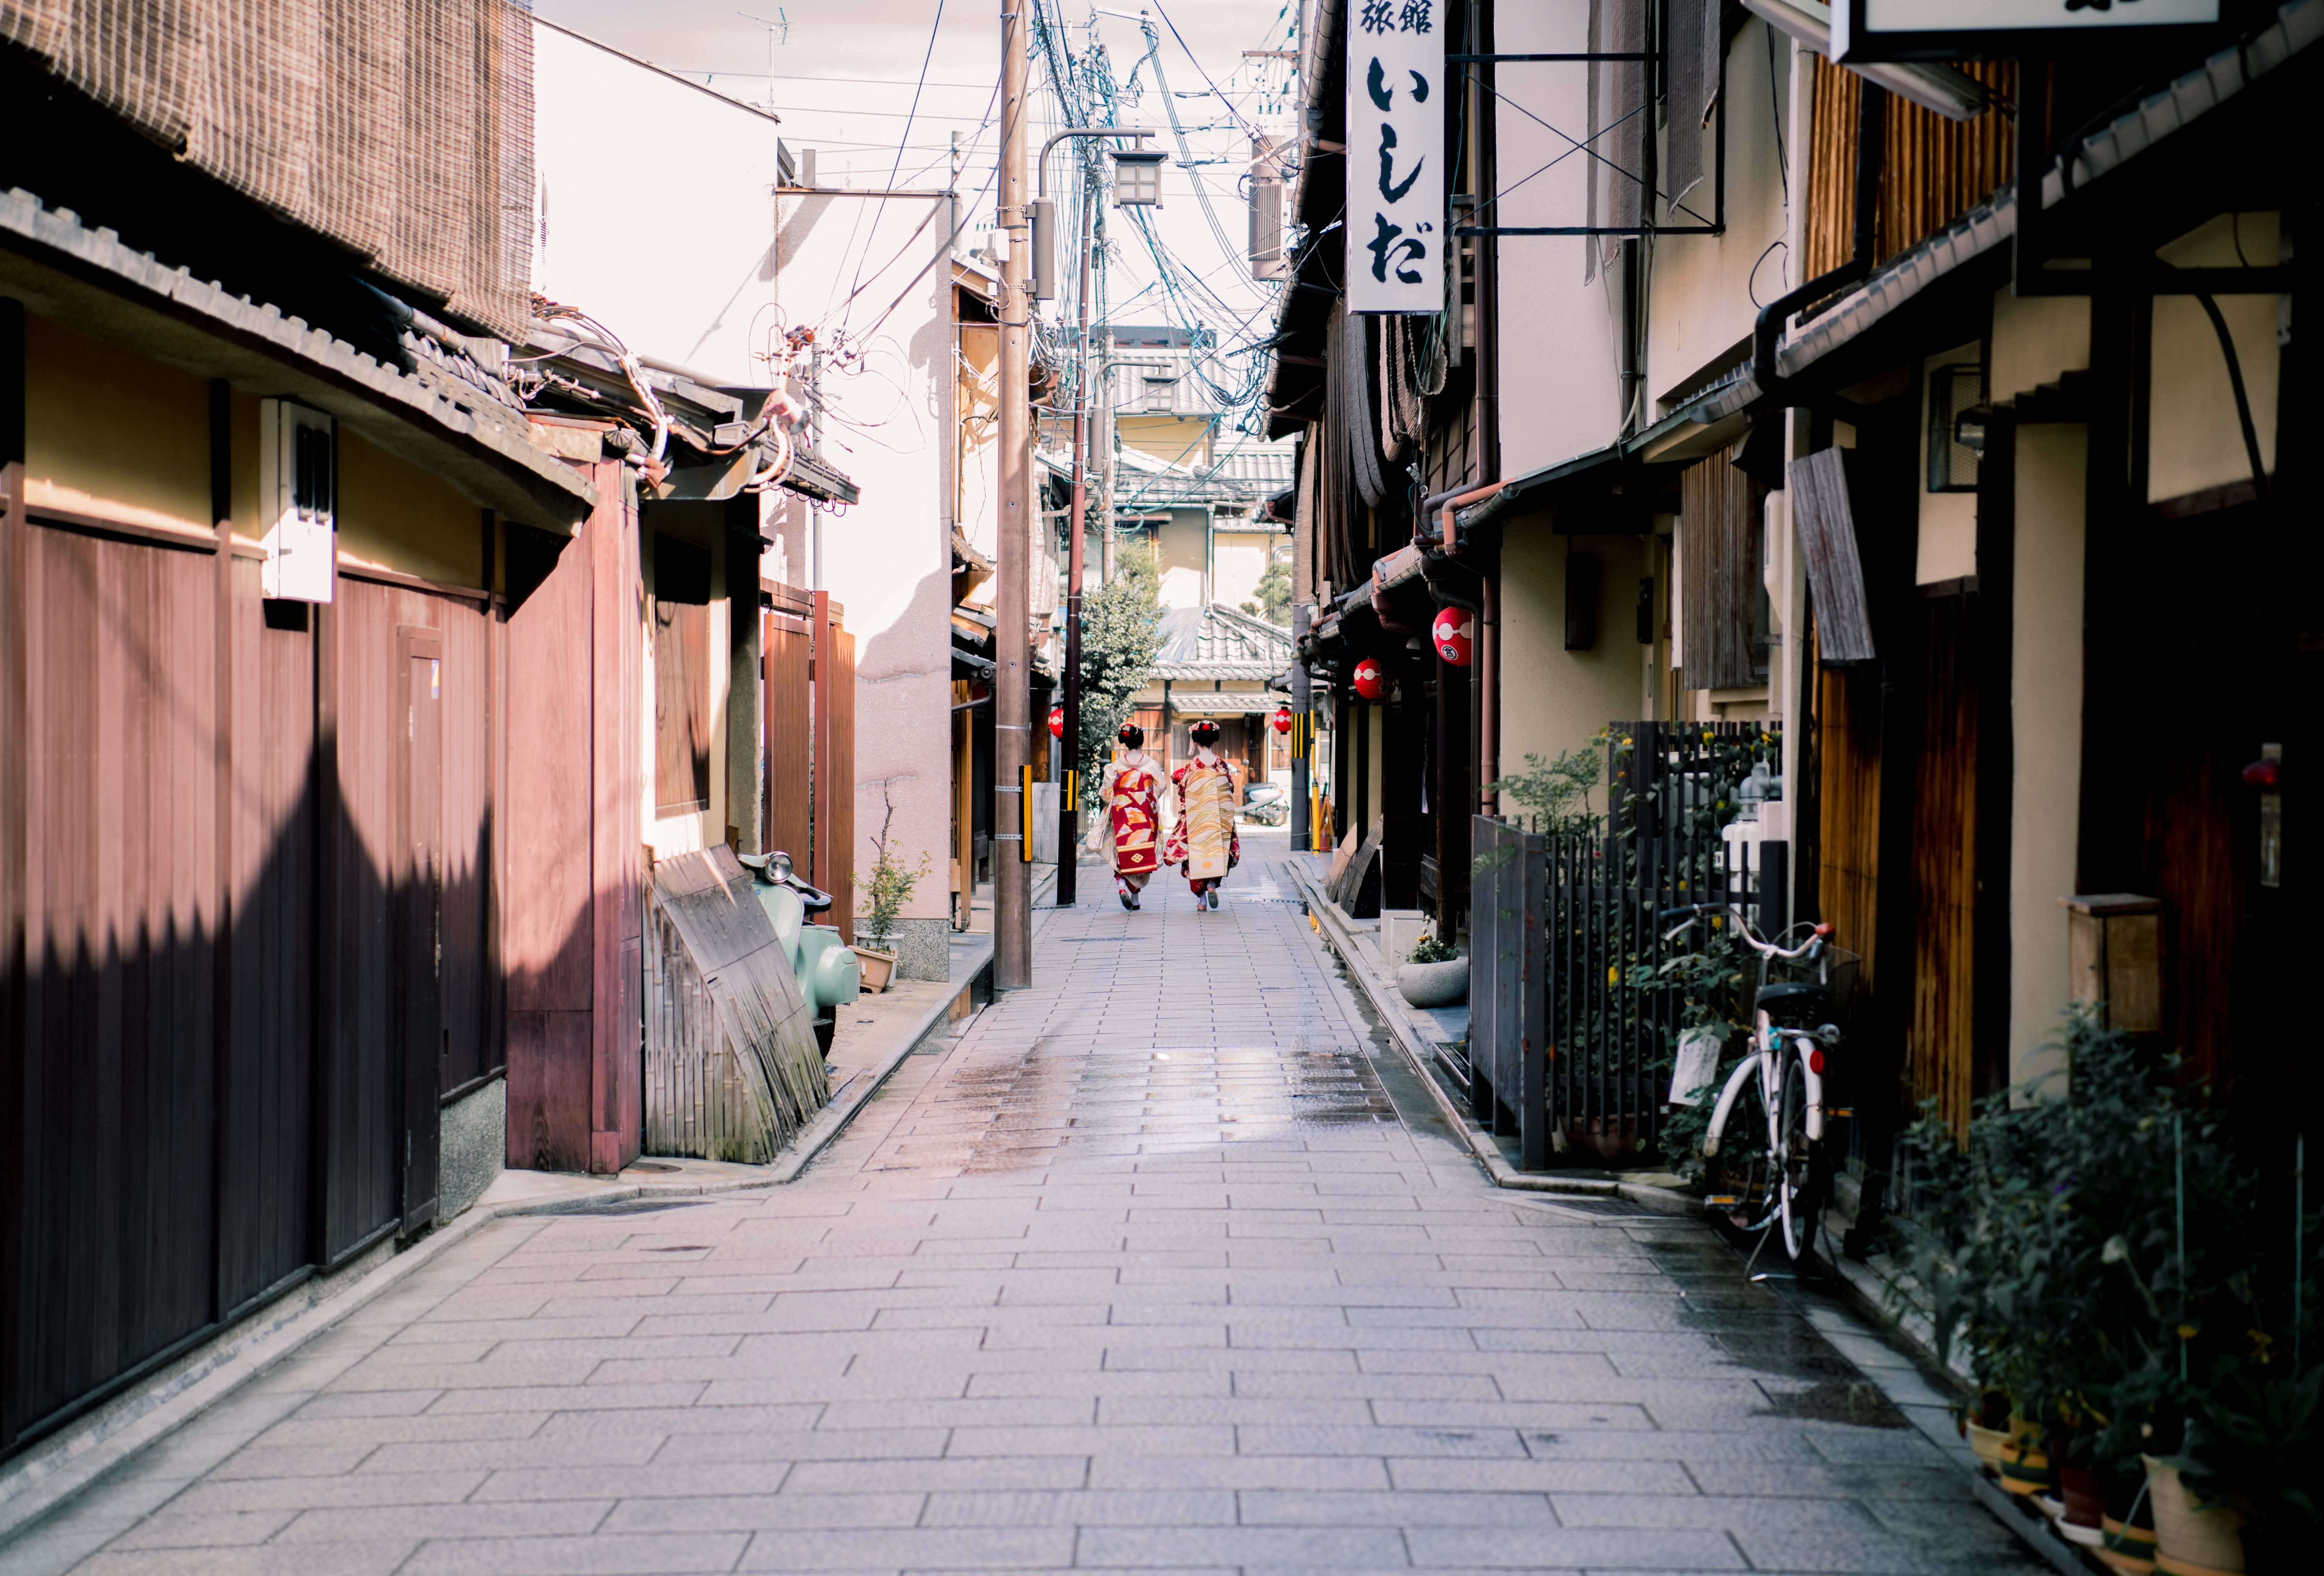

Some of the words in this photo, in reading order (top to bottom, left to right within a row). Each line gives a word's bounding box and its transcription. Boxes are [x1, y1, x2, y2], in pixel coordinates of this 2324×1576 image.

[1359, 0, 1433, 36] 旅館
[1367, 56, 1432, 284] いしだ
